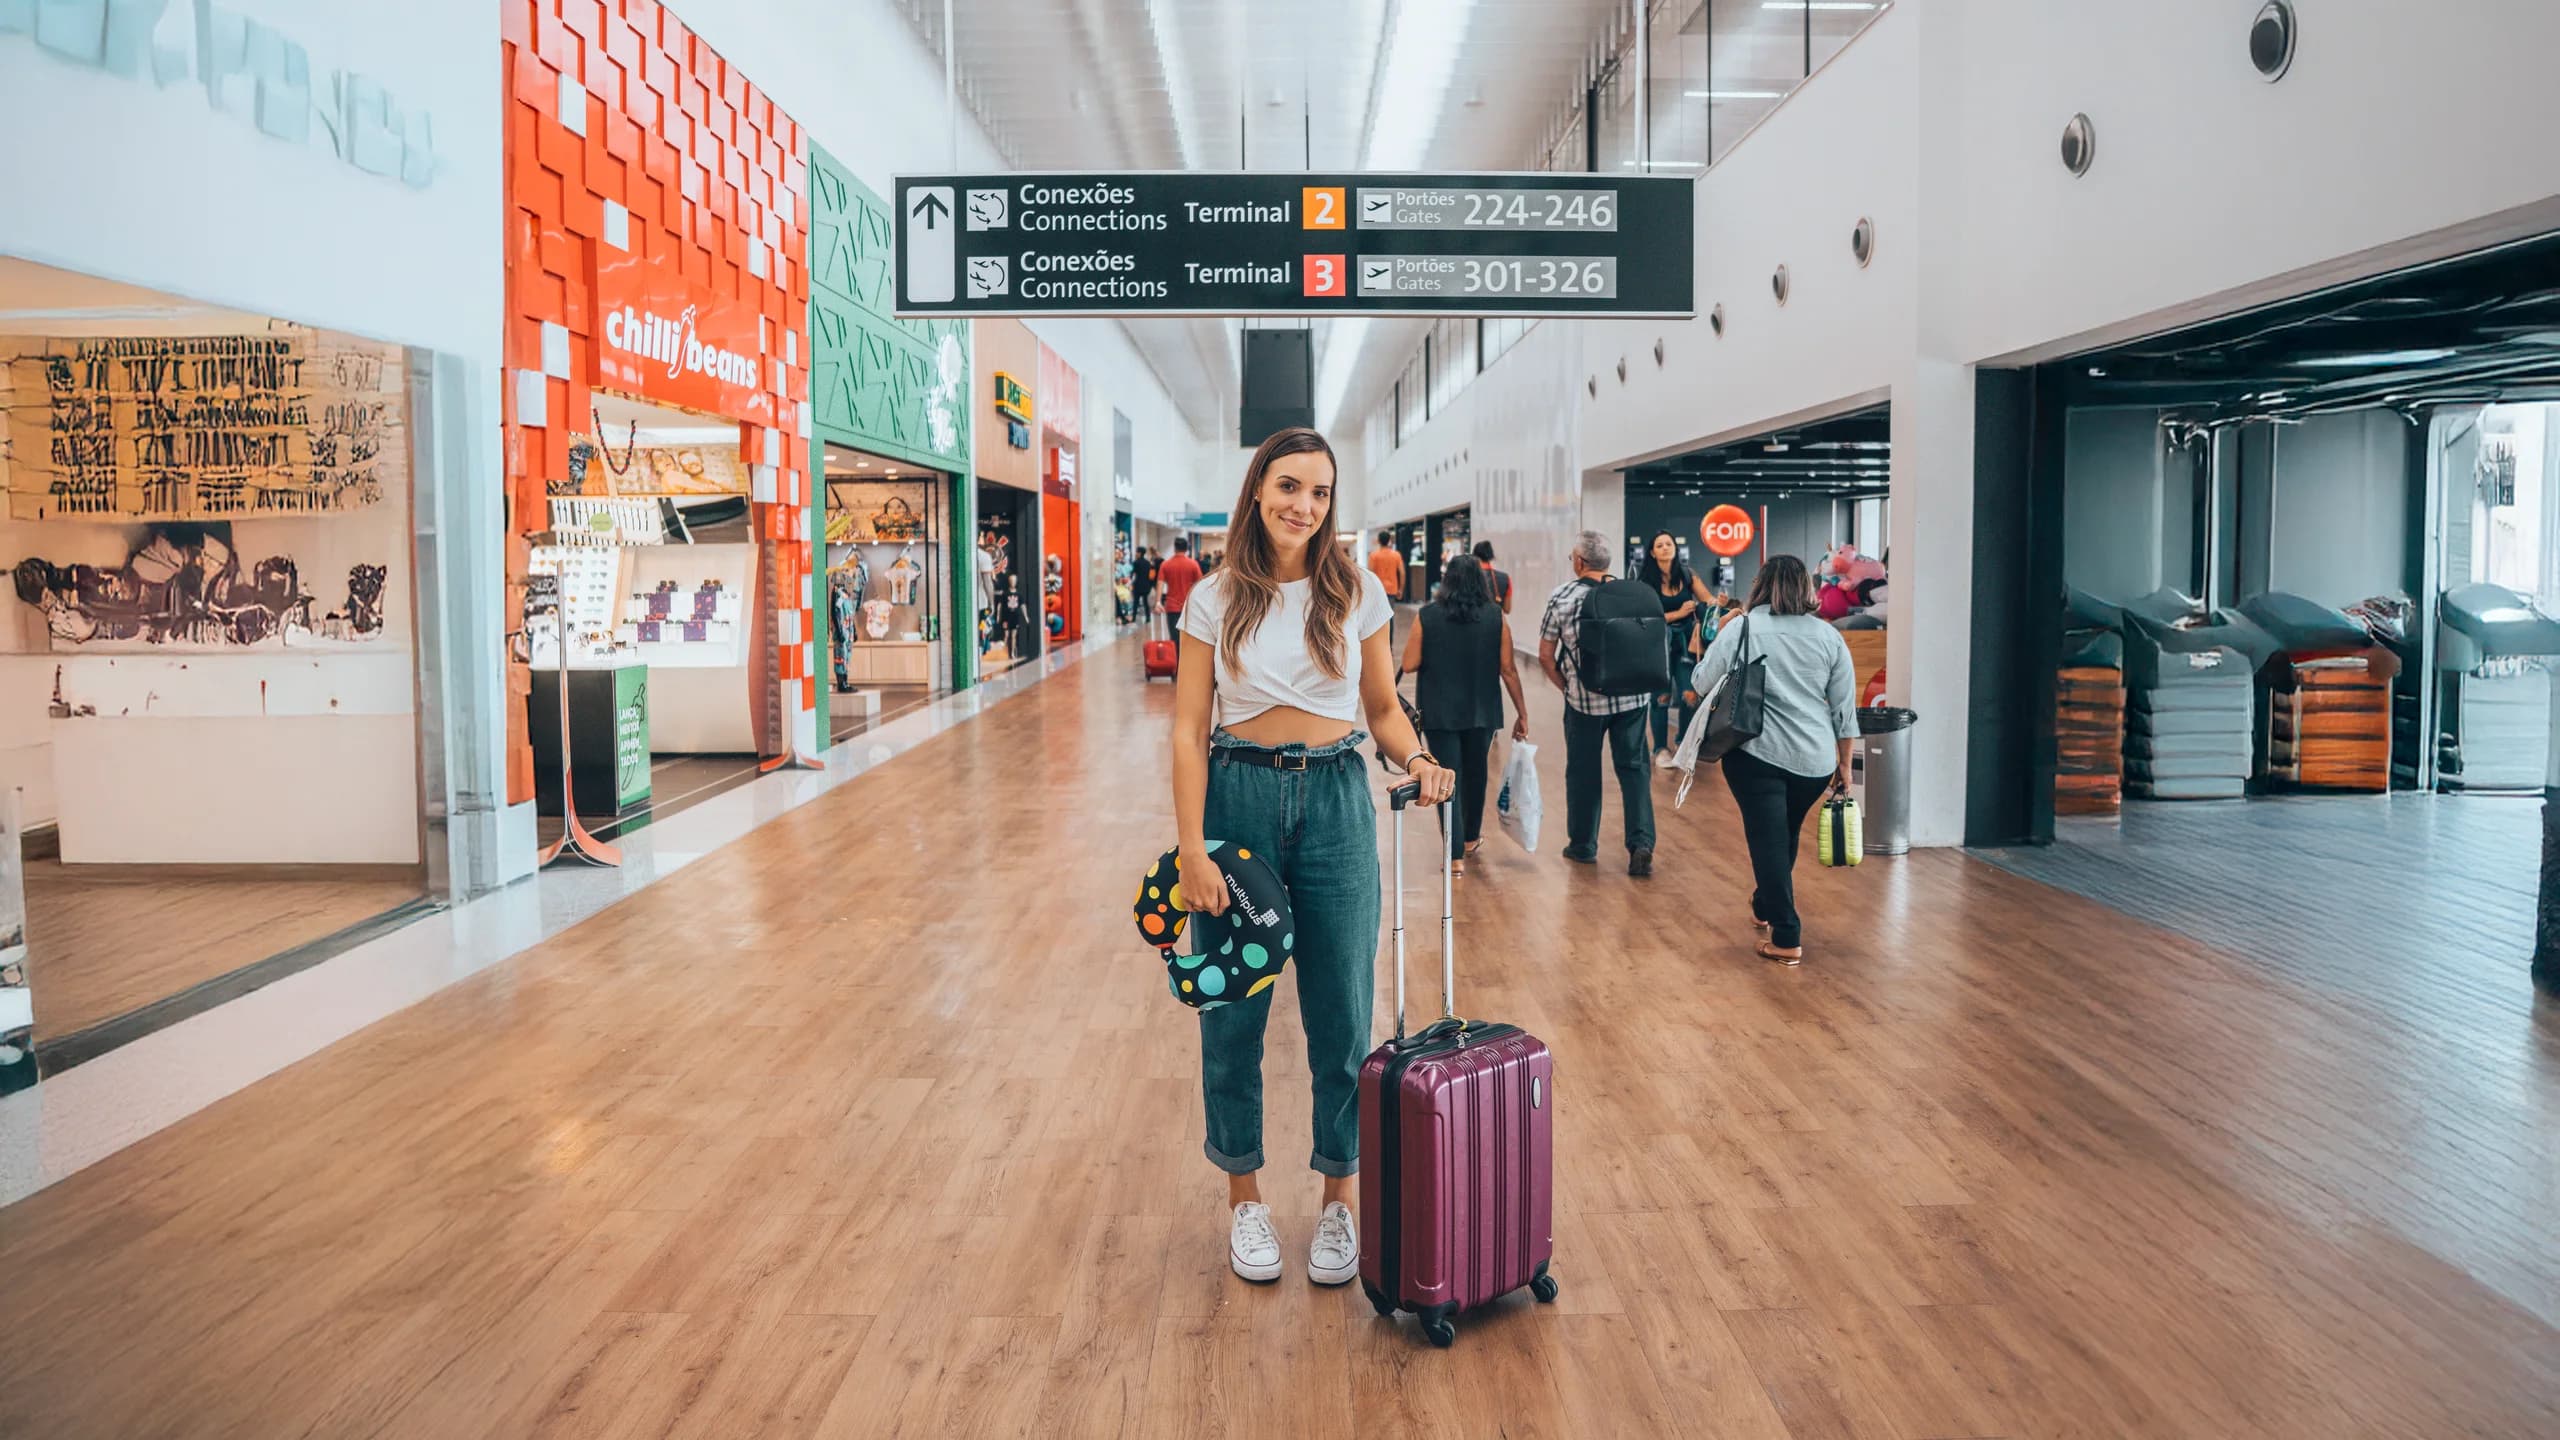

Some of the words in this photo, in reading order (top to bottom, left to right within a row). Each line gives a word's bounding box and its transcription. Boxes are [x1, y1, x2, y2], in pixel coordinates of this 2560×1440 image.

[1019, 182, 1135, 205] Conexões
[1396, 191, 1456, 206] Portões
[1019, 208, 1168, 231] Connections
[1184, 200, 1290, 223] Terminal
[1314, 192, 1335, 225] 2
[1396, 209, 1442, 224] Gates
[1464, 194, 1612, 227] 224-246
[1020, 249, 1135, 272] Conexões
[1396, 258, 1456, 273] Portões
[1020, 275, 1168, 299] Connections
[1184, 261, 1290, 284] Terminal
[1315, 259, 1334, 292] 3
[1396, 276, 1442, 291] Gates
[1464, 260, 1605, 293] 301-326
[606, 305, 681, 365] chilli
[686, 330, 757, 389] beans
[1705, 522, 1751, 540] FOM
[1225, 873, 1264, 926] multiplus
